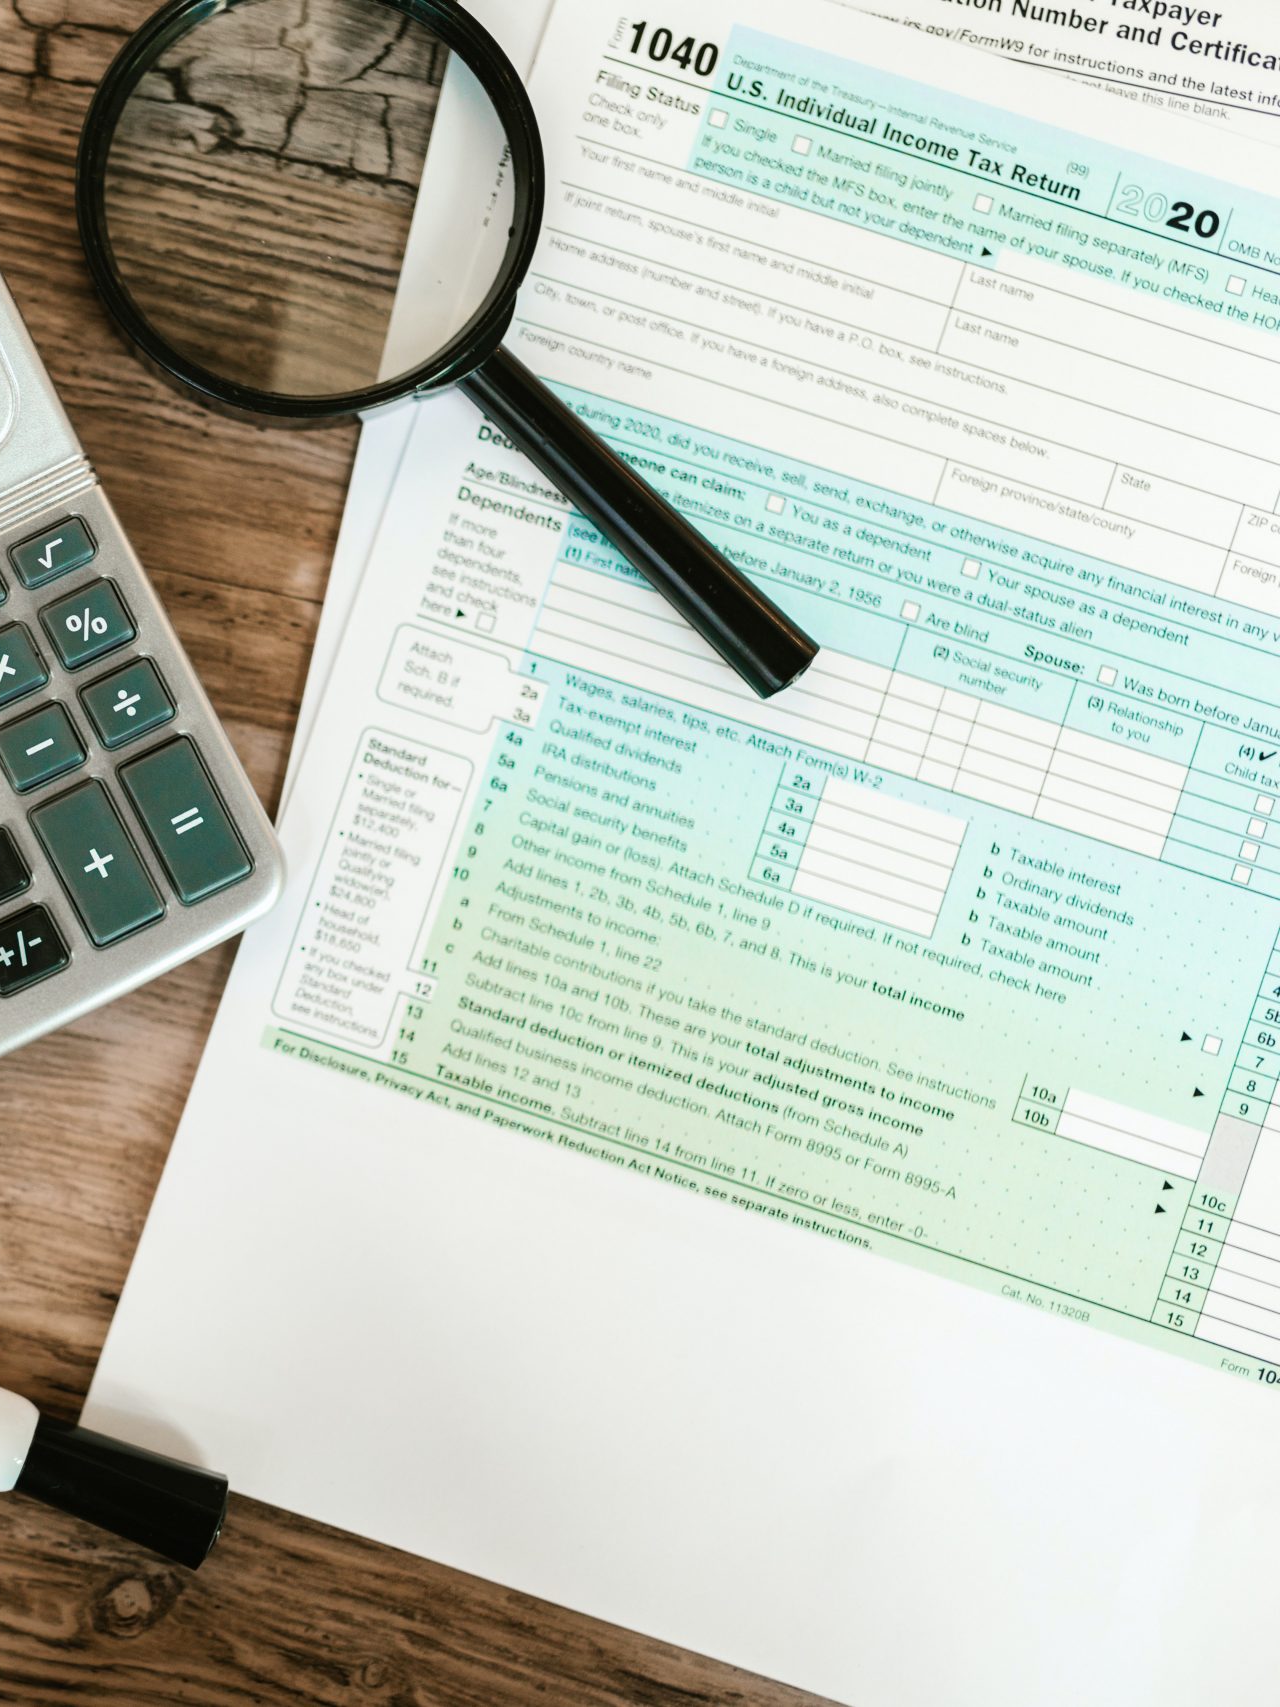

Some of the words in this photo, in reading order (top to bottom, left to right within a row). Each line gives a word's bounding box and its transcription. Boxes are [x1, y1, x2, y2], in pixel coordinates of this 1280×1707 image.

[630, 21, 718, 76] 1040
[1011, 0, 1108, 34] Number
[1116, 24, 1162, 46] and
[1170, 31, 1280, 70] Certifica
[1028, 43, 1049, 57] for
[1053, 51, 1143, 78] instructions
[1148, 72, 1177, 85] and
[1182, 76, 1205, 91] the
[1210, 81, 1253, 101] latest
[595, 69, 641, 99] Filing
[646, 86, 700, 115] Status
[1135, 92, 1163, 106] this
[1167, 96, 1190, 111] line
[727, 72, 766, 100] U.S.
[776, 88, 877, 134] Individual
[882, 122, 958, 160] Income
[969, 149, 1003, 176] Tax
[1010, 164, 1080, 200] Return
[733, 118, 777, 143] Single
[816, 144, 872, 173] Married
[874, 163, 908, 187] filing
[909, 175, 953, 201] jointly
[1066, 162, 1089, 178] (99)
[1115, 184, 1220, 239] 2020
[998, 203, 1053, 231] Married
[1055, 222, 1088, 246] filing
[1092, 237, 1164, 269] separately
[1167, 259, 1208, 284] (MFS)
[1228, 239, 1260, 258] OMB
[969, 271, 997, 289] Last
[999, 283, 1034, 301] name
[465, 462, 570, 505] Age/Blindness
[1120, 472, 1150, 491] State
[457, 485, 562, 532] Dependents
[951, 467, 998, 493] Foreign
[1000, 486, 1135, 539] province/state/county
[988, 568, 1019, 589] Your
[1023, 584, 1075, 608] spouse
[1078, 602, 1095, 615] as
[1099, 609, 1108, 620] a
[1112, 612, 1189, 646] dependent
[925, 612, 950, 630] Are
[953, 621, 989, 642] blind
[933, 644, 950, 661] (2)
[952, 650, 991, 672] Social
[993, 667, 1042, 691] security
[1024, 644, 1084, 674] Spouse:
[958, 673, 1006, 694] number
[1087, 695, 1104, 712] (3)
[1107, 701, 1183, 736] Relationship
[1124, 676, 1153, 697] Was
[1157, 687, 1190, 709] born
[1193, 699, 1239, 725] before
[1111, 721, 1123, 734] to
[1126, 728, 1150, 743] you
[1238, 744, 1255, 760] (4)
[1224, 763, 1258, 782] Child
[1260, 774, 1280, 789] tax
[990, 842, 1000, 854] b
[983, 865, 992, 878] b
[1011, 847, 1064, 877] Taxable
[1067, 870, 1120, 895] interest
[976, 886, 985, 899] b
[1001, 873, 1062, 904] Ordinary
[1065, 894, 1134, 926] dividends
[997, 892, 1050, 920] Taxable
[1053, 915, 1108, 940] amount
[872, 981, 906, 1001] total
[909, 994, 964, 1020] income
[1257, 1031, 1276, 1047] 6b
[458, 996, 526, 1029] Standard
[529, 1022, 604, 1056] deduction
[608, 1050, 624, 1060] or
[627, 1054, 693, 1084] itemized
[695, 1077, 778, 1113] deductions
[1255, 1055, 1264, 1068] 7
[745, 1042, 779, 1061] total
[783, 1057, 875, 1094] adjustments
[880, 1087, 895, 1100] to
[899, 1093, 954, 1120] income
[1033, 1086, 1056, 1103] 10a
[1246, 1079, 1256, 1092] 8
[752, 1074, 819, 1101] adjusted
[822, 1096, 863, 1116] gross
[868, 1111, 923, 1135] income
[1025, 1109, 1049, 1126] 10b
[1239, 1103, 1248, 1115] 9
[273, 1038, 295, 1053] For
[299, 1047, 370, 1081] Disclosure,
[375, 1072, 423, 1099] Privacy
[425, 1090, 450, 1108] Act,
[455, 1103, 480, 1116] and
[483, 1109, 553, 1141] Paperwork
[557, 1134, 624, 1165] Reduction
[627, 1158, 651, 1174] Act
[654, 1167, 699, 1192] Notice,
[704, 1186, 727, 1199] see
[730, 1195, 788, 1221] separate
[792, 1214, 871, 1249] instructions.
[1202, 1194, 1226, 1211] 10c
[1198, 1219, 1213, 1233] 11
[1191, 1242, 1207, 1257] 12
[1183, 1265, 1199, 1280] 13
[1001, 1284, 1022, 1300] Cat.
[1026, 1292, 1044, 1307] No.
[1050, 1301, 1090, 1322] 11320B
[1175, 1289, 1191, 1303] 14
[1168, 1312, 1184, 1326] 15
[1220, 1358, 1249, 1376] Form
